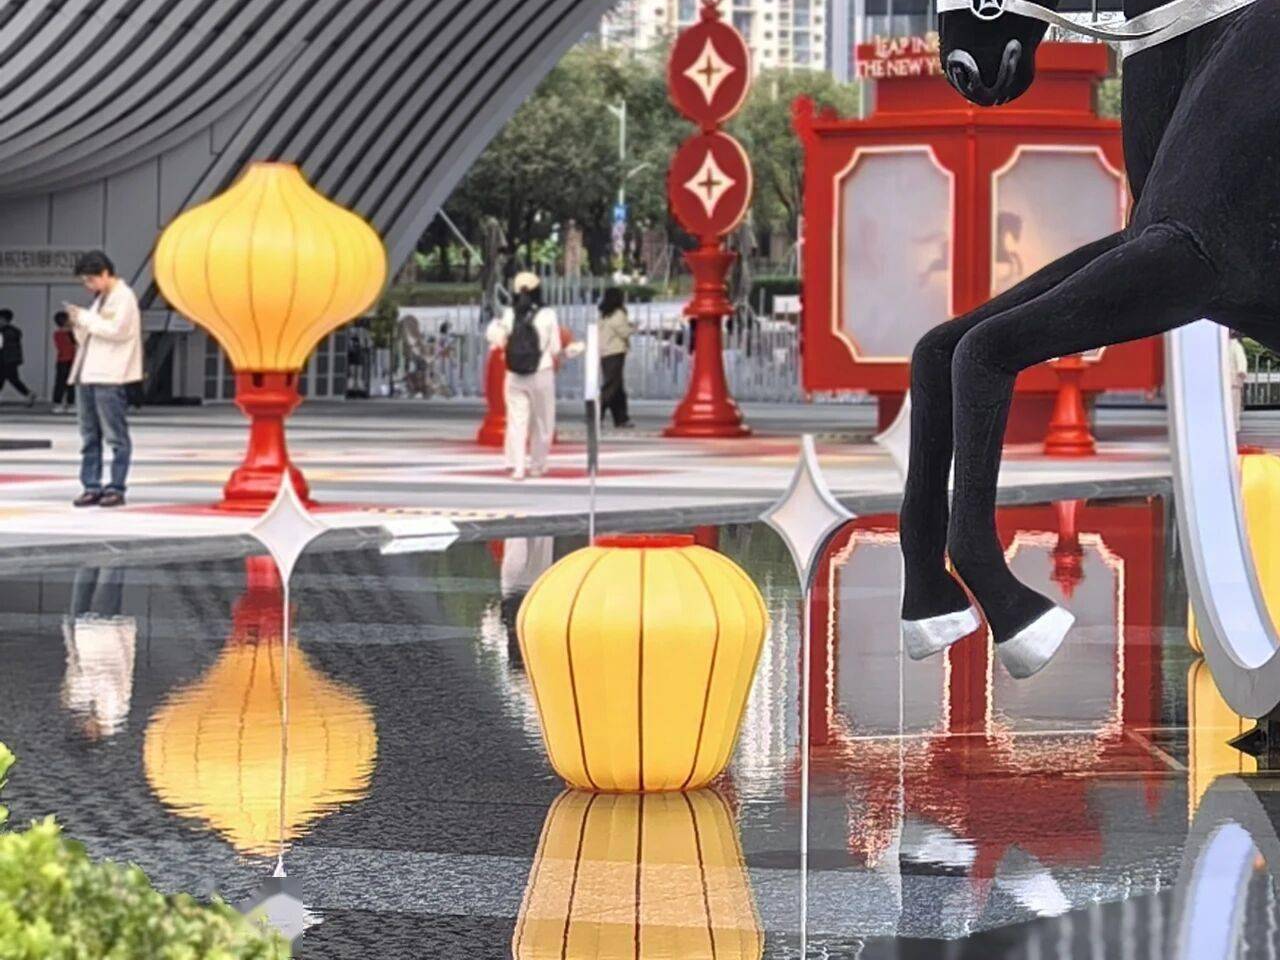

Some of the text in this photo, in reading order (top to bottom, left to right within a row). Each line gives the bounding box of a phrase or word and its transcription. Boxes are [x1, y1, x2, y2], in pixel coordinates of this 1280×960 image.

[874, 35, 909, 58] LEAP
[855, 60, 885, 77] THE
[886, 58, 923, 77] NEW
